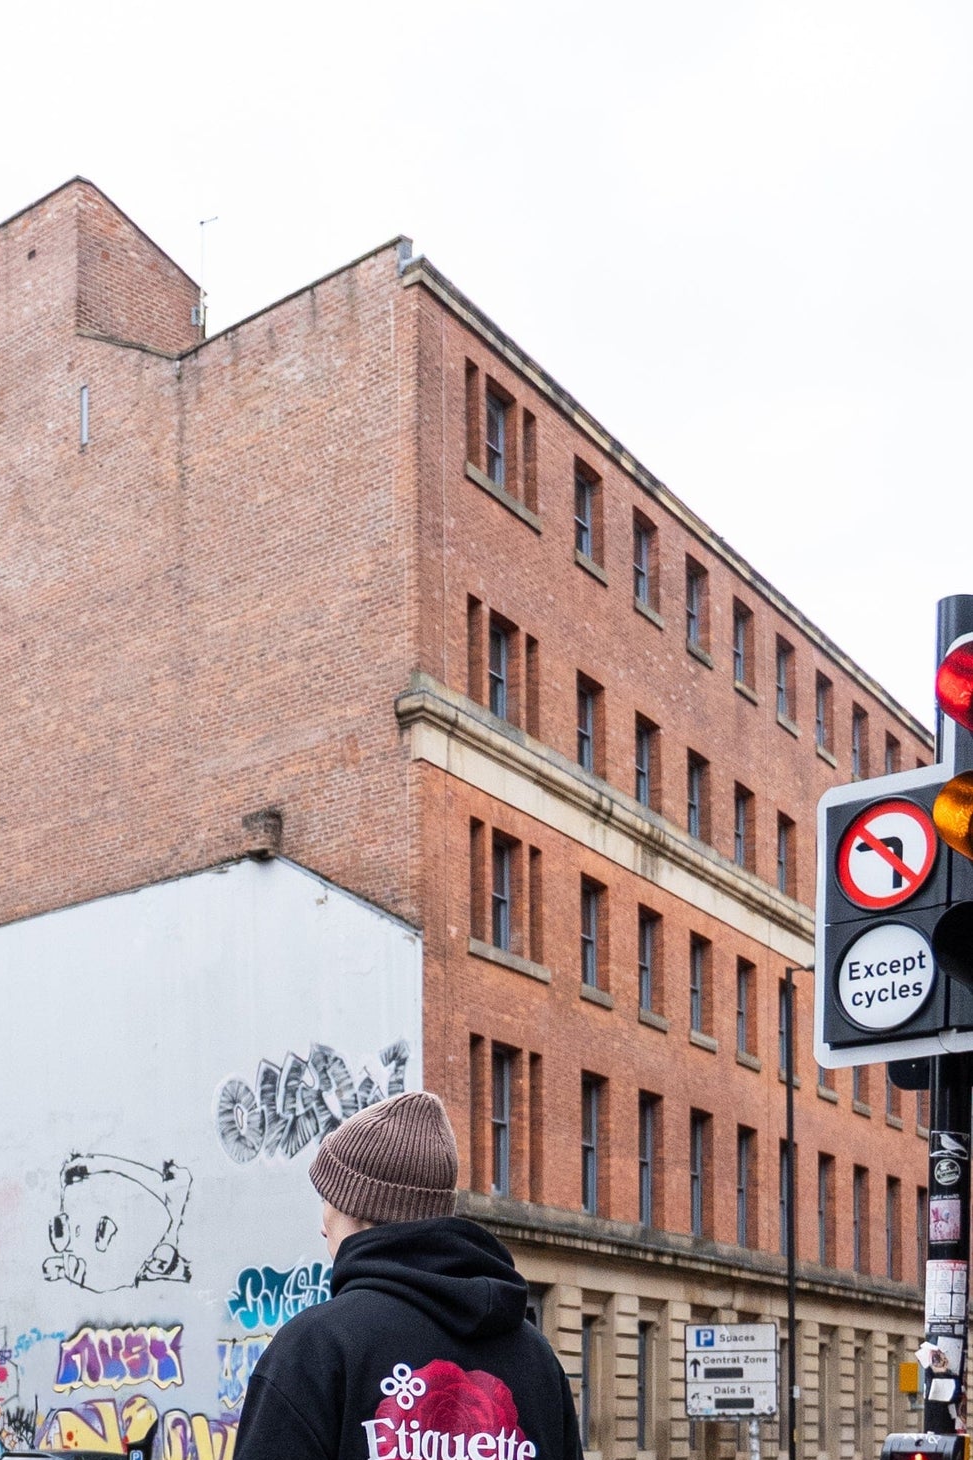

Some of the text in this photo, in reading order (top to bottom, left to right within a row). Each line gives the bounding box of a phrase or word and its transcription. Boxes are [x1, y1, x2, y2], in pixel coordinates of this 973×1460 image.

[849, 950, 926, 981] Except
[852, 981, 923, 1008] cycles
[700, 1330, 755, 1346] P Spaces
[702, 1355, 768, 1364] Central Zone
[714, 1386, 736, 1395] Dale
[739, 1386, 751, 1394] St
